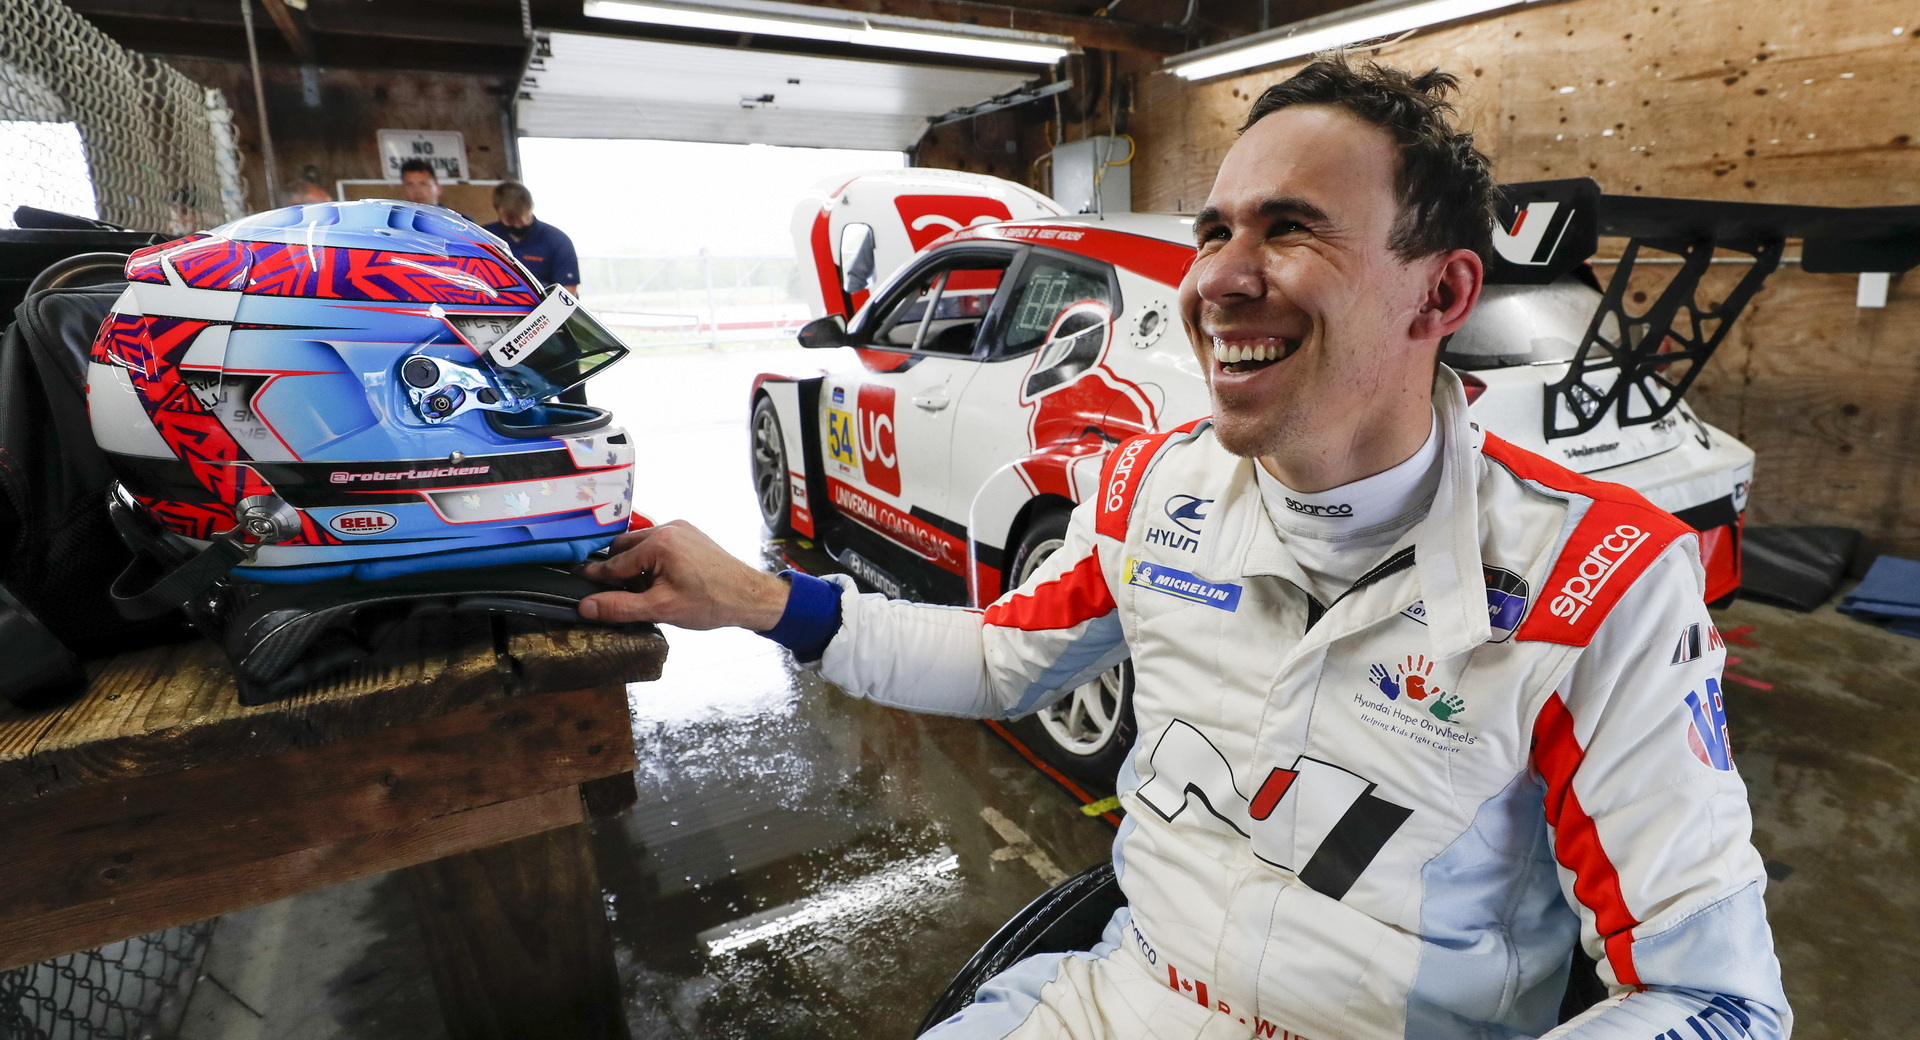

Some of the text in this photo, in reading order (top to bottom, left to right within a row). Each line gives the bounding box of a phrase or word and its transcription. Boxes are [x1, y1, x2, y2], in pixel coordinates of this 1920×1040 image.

[412, 141, 433, 154] NO
[513, 326, 532, 344] BRYAN
[531, 314, 547, 329] HERTA
[518, 318, 551, 348] AUTOSPORT
[829, 412, 853, 463] 54
[858, 407, 897, 469] UC
[330, 465, 491, 484] @robertwickens
[1106, 439, 1151, 513] sparco
[340, 516, 388, 528] BELL
[835, 485, 878, 521] UNIVERSAL
[880, 508, 929, 546] COATING
[1285, 497, 1353, 517] sparco
[1145, 527, 1199, 554] HYUN
[1154, 574, 1230, 601] MICHELIN
[1550, 525, 1648, 623] sparco
[1353, 693, 1477, 745] Hyundai Hope On Wheels
[1360, 713, 1460, 754] Helping Kids Fight Cancer
